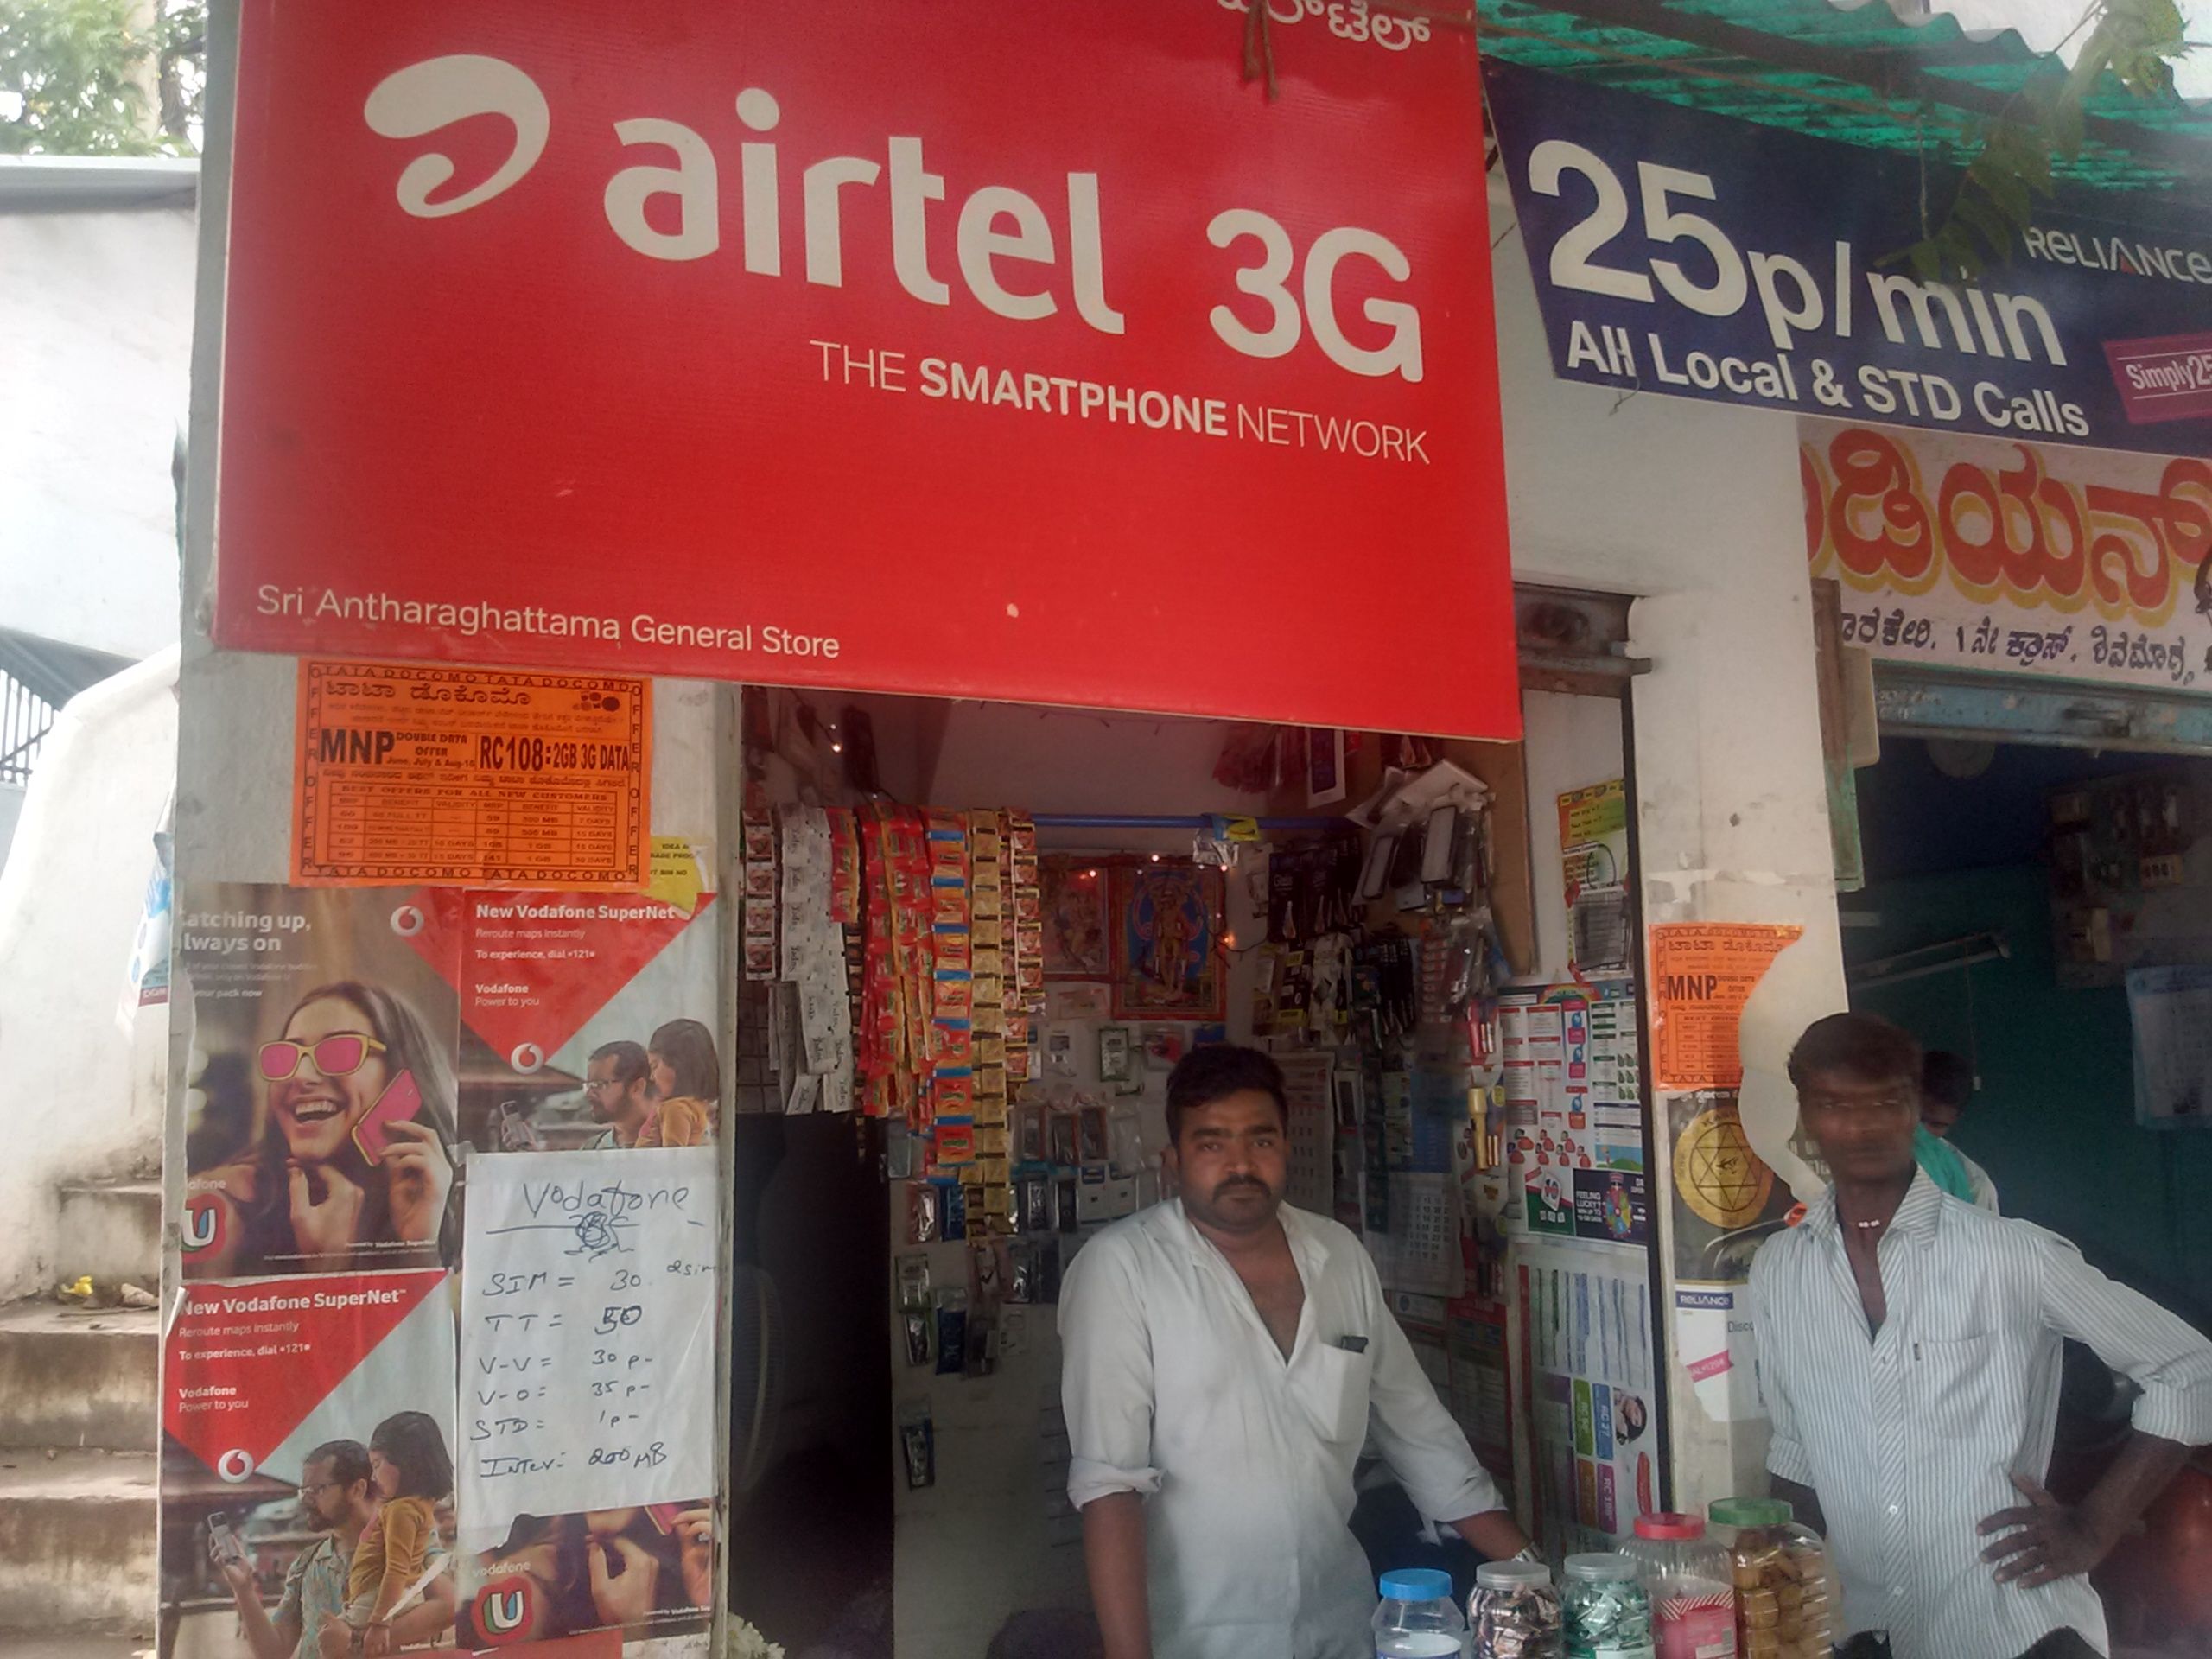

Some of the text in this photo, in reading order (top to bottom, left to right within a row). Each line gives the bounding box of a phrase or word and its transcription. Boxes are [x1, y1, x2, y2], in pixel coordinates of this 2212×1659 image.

[605, 87, 1424, 383] airtel 3G
[1567, 321, 2091, 438] All Local & STD Calls
[810, 340, 1431, 464] THE SMARTPHONE NETWORK
[257, 583, 841, 659] Sri Antharaghattama General Store
[327, 665, 630, 692] TATA DOCOMO TATA DOCOMO
[320, 728, 396, 765] MNP
[396, 731, 467, 744] DOUBLE DATA
[415, 746, 448, 757] OFFER
[580, 742, 596, 770] 3G
[600, 744, 630, 772] DATA
[380, 786, 431, 797] OFFERS
[498, 791, 526, 799] NEW
[532, 791, 607, 802] CUSTOMERS
[376, 867, 471, 879] DOCOMO
[536, 870, 626, 881] DOCOMO
[277, 913, 312, 933] up,
[476, 904, 676, 923] New Vodafone SuperNet
[181, 932, 282, 956] lways on
[475, 927, 586, 942] Reroute maps instantly
[476, 949, 566, 961] To experience, dial
[241, 989, 264, 998] now
[475, 983, 529, 995] Vodafone
[1666, 974, 1719, 1001] MNP
[476, 996, 540, 1009] Power to you
[1576, 1190, 1601, 1201] FEELING
[482, 1270, 548, 1297] SIM
[610, 1268, 642, 1292] 30
[222, 1295, 310, 1314] Vodafone
[179, 1319, 300, 1338] Reroute maps instantly
[594, 1304, 643, 1336] 50
[179, 1350, 192, 1361] To
[194, 1346, 256, 1361] experience,
[257, 1344, 277, 1357] dial
[179, 1385, 237, 1399] Vodafone
[179, 1399, 250, 1413] Power to you
